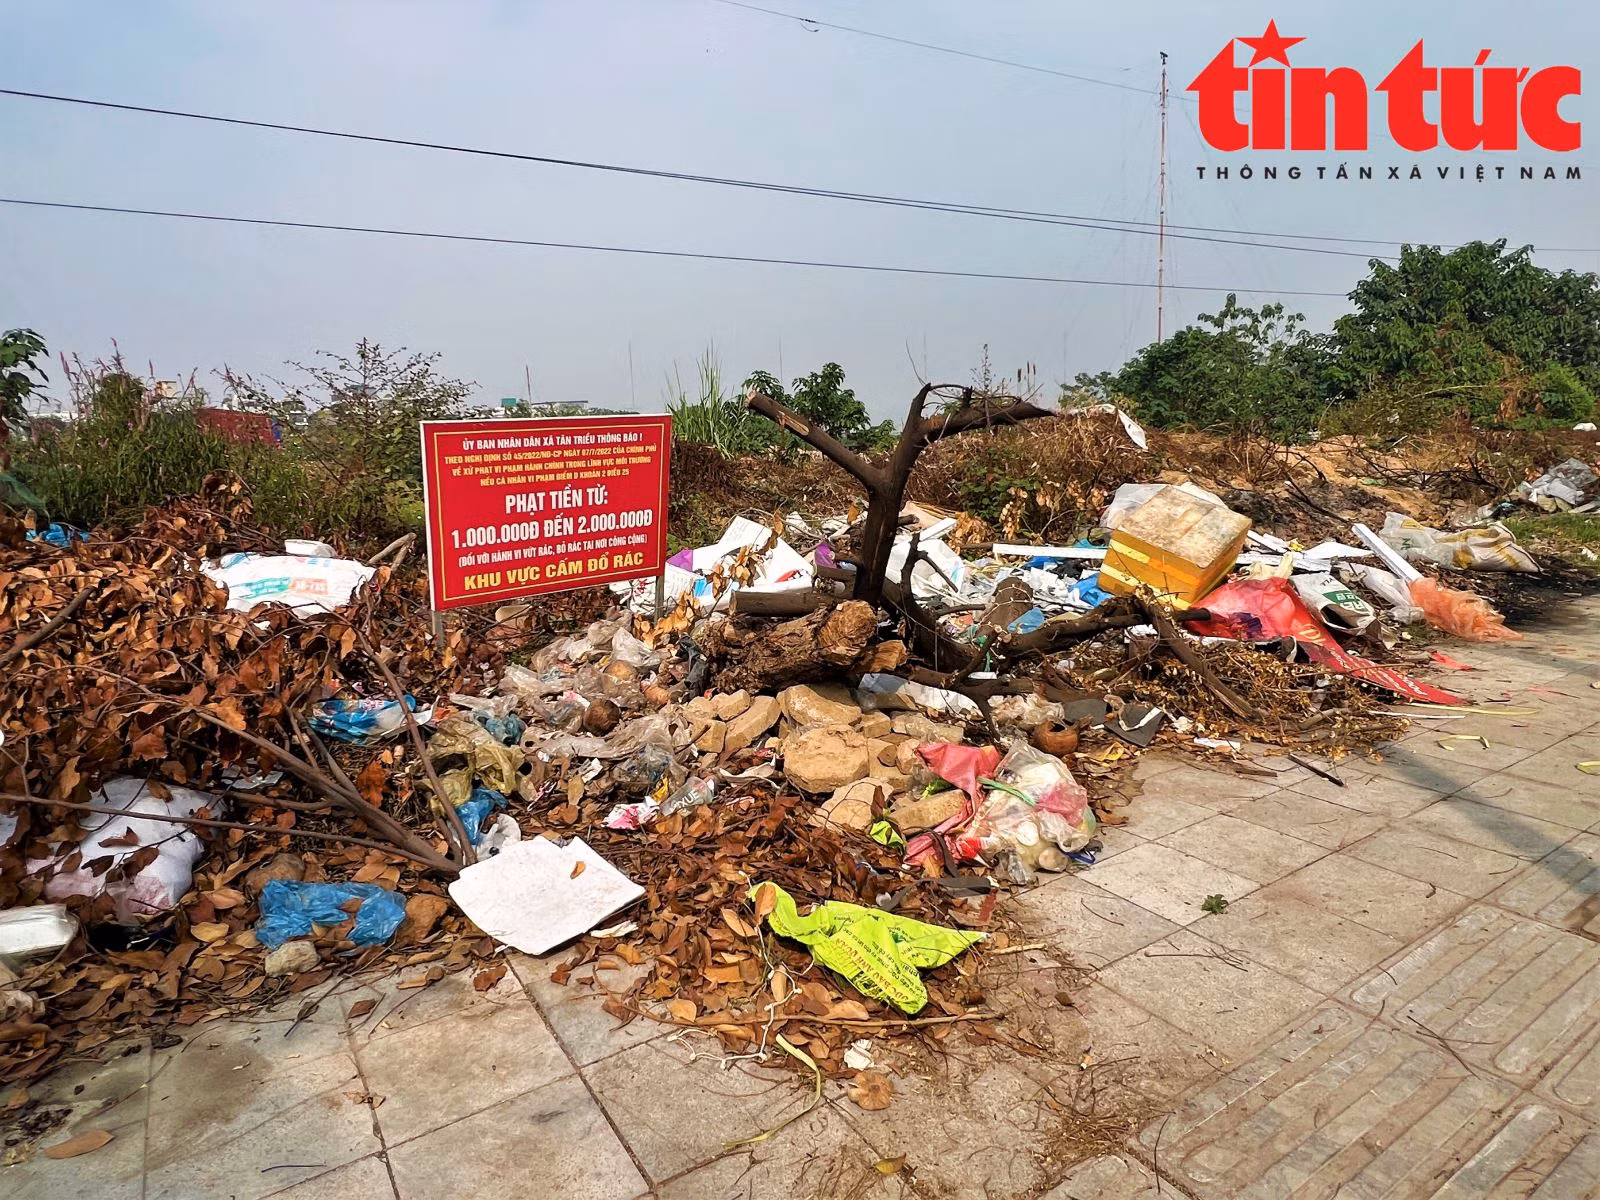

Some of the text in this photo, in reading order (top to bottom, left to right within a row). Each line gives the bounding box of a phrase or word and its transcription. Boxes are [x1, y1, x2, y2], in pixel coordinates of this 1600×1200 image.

[476, 439, 496, 450] BAN
[497, 436, 521, 449] NHÂN
[523, 435, 541, 447] DÂN
[597, 432, 621, 443] THÔNG
[445, 455, 463, 465] THEO
[528, 475, 535, 483] VI
[505, 483, 608, 516] PHẠT TIỀN TỪ:
[451, 509, 653, 549] 1.000.000Đ ĐẾN 2.000.000Đ
[491, 550, 513, 563] HÀNH
[514, 549, 522, 560] VI
[538, 544, 555, 556] RÁC,
[567, 541, 582, 553] RÁC
[583, 540, 594, 552] TẠI
[464, 550, 644, 591] KHU VỰC CẤM ĐỔ RÁC
